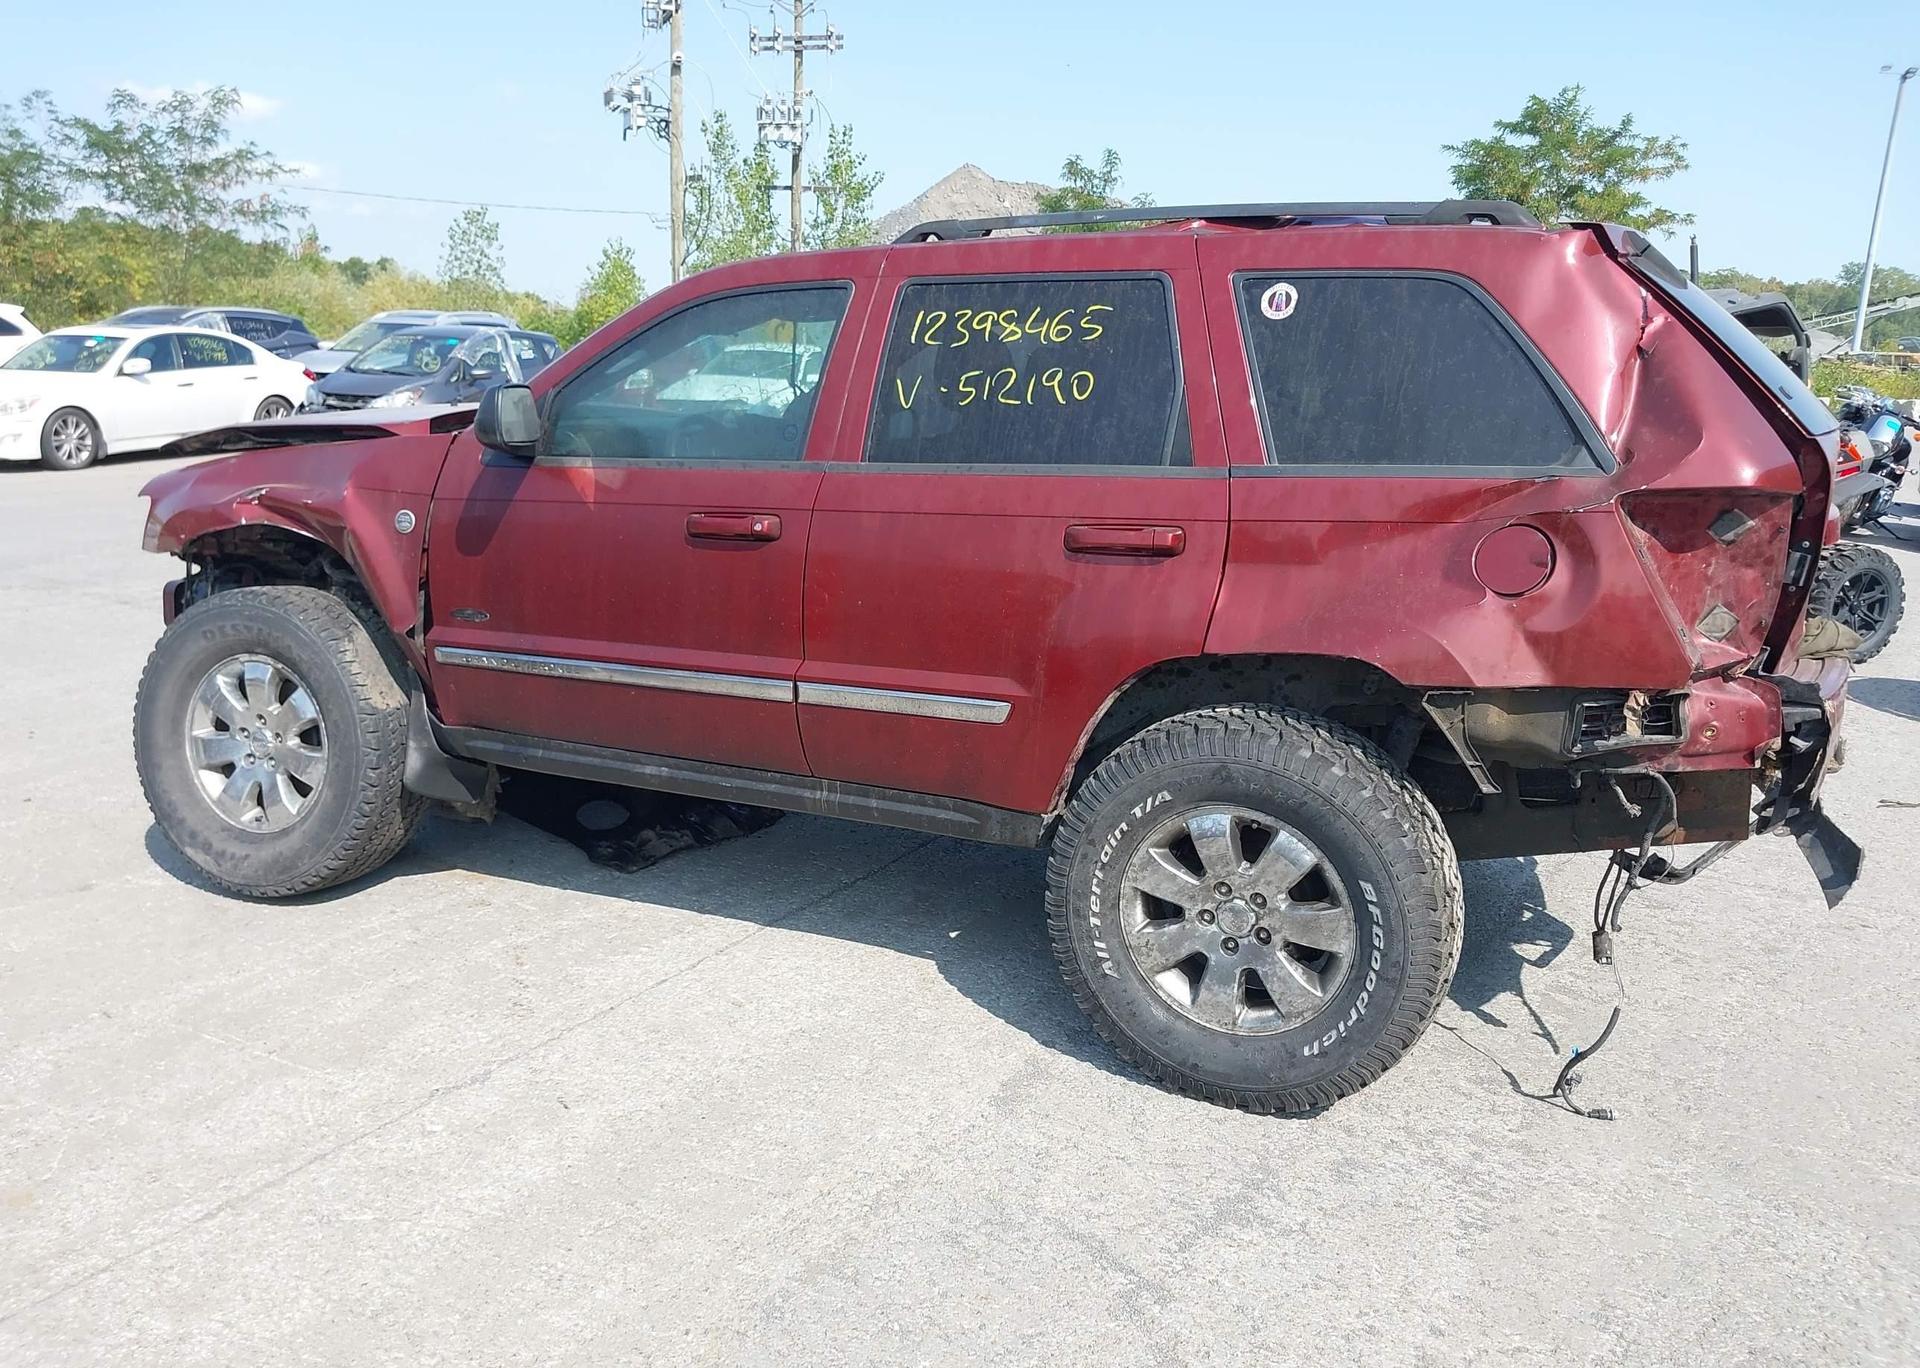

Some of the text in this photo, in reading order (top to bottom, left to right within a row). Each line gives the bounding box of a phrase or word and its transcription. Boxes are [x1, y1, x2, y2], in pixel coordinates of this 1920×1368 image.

[909, 304, 1114, 348] 12398465
[1089, 789, 1174, 980] All-Terrain T/A
[1302, 878, 1386, 1058] BFGoodrich
